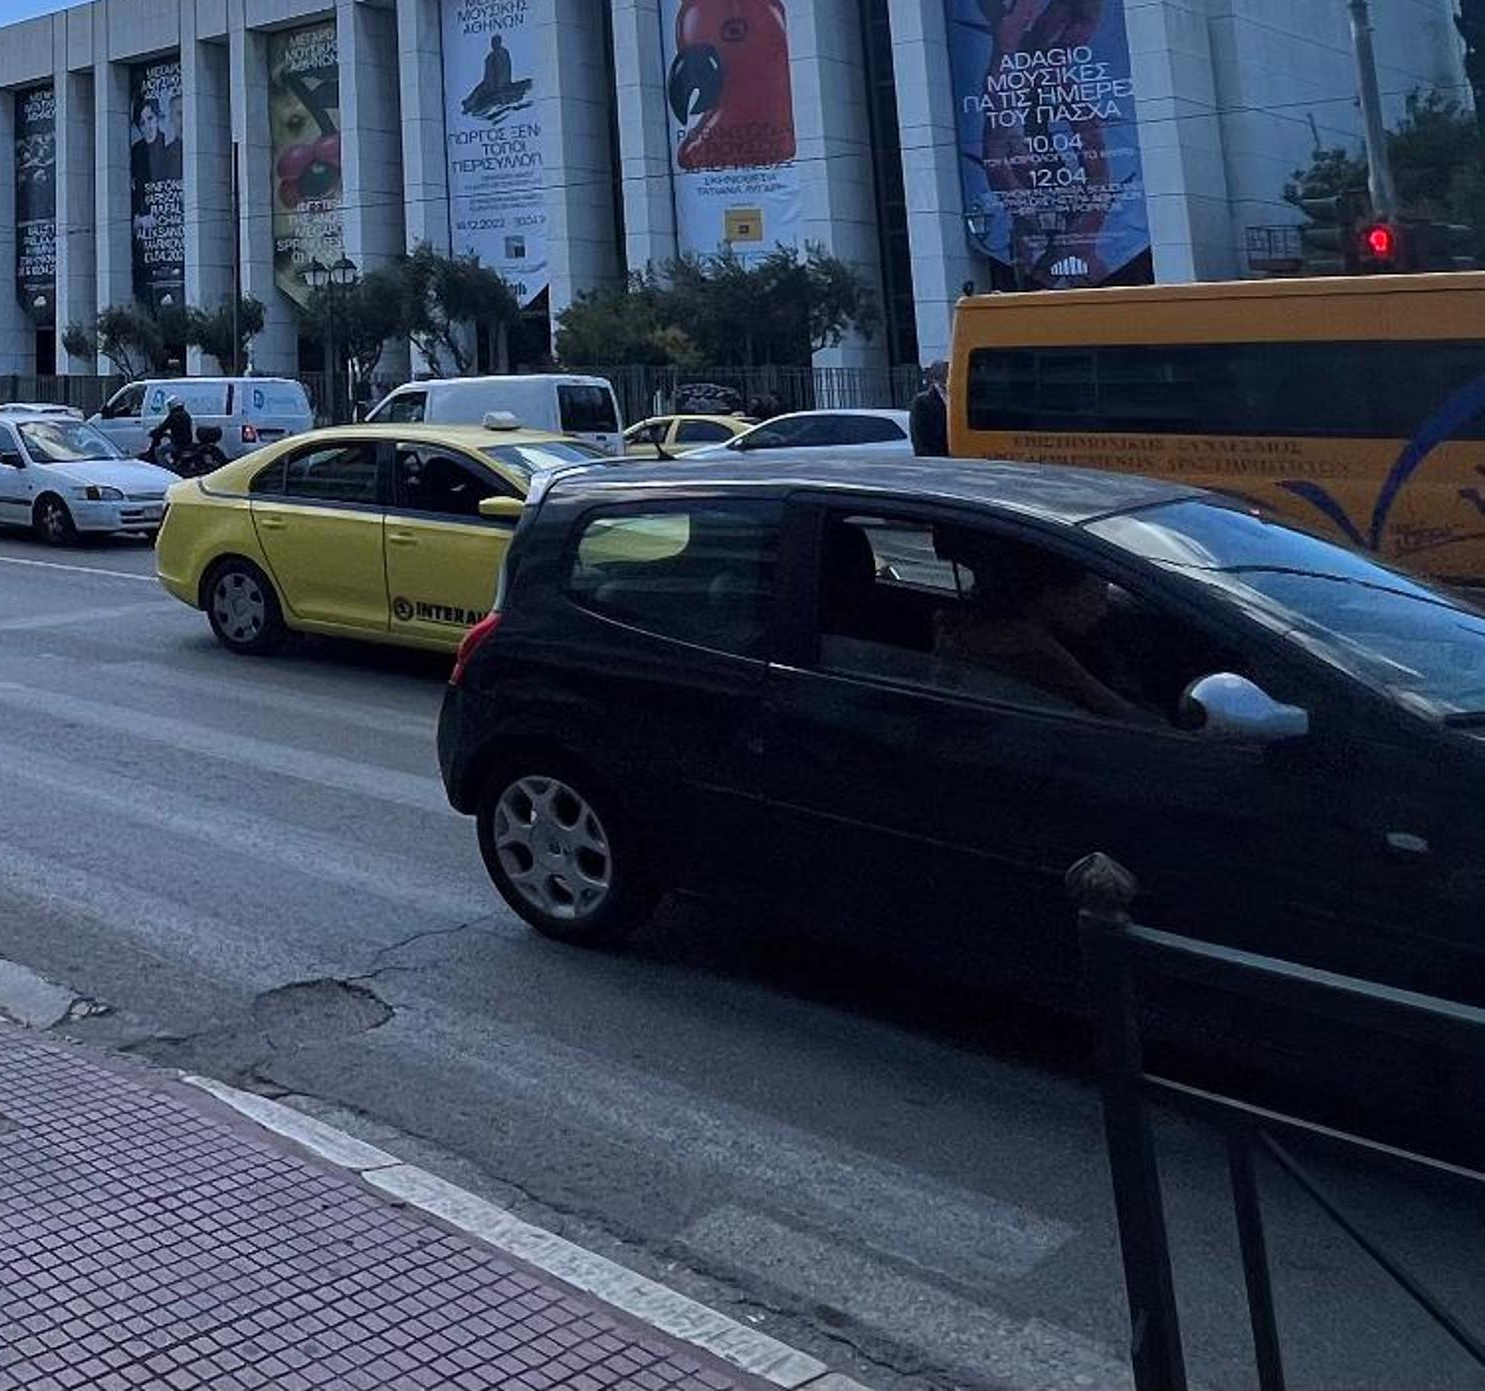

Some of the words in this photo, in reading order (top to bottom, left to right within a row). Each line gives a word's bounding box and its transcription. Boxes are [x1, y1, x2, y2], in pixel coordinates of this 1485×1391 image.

[463, 14, 524, 34] ΑΘΗΝΩΝ
[999, 46, 1092, 71] ADAGIO
[987, 62, 1111, 92] ΜΟΥΣΙΚΕΣ
[997, 88, 1032, 109] ΤΙΣ
[986, 109, 1030, 128] ΤΟΥ
[1037, 100, 1122, 124] ΠΑΣΧΑ
[511, 123, 542, 139] ΞΕΝ
[481, 141, 527, 157] ΤΟΠΟΙ
[1024, 133, 1083, 153] 10.04
[1029, 167, 1088, 187] 12.04
